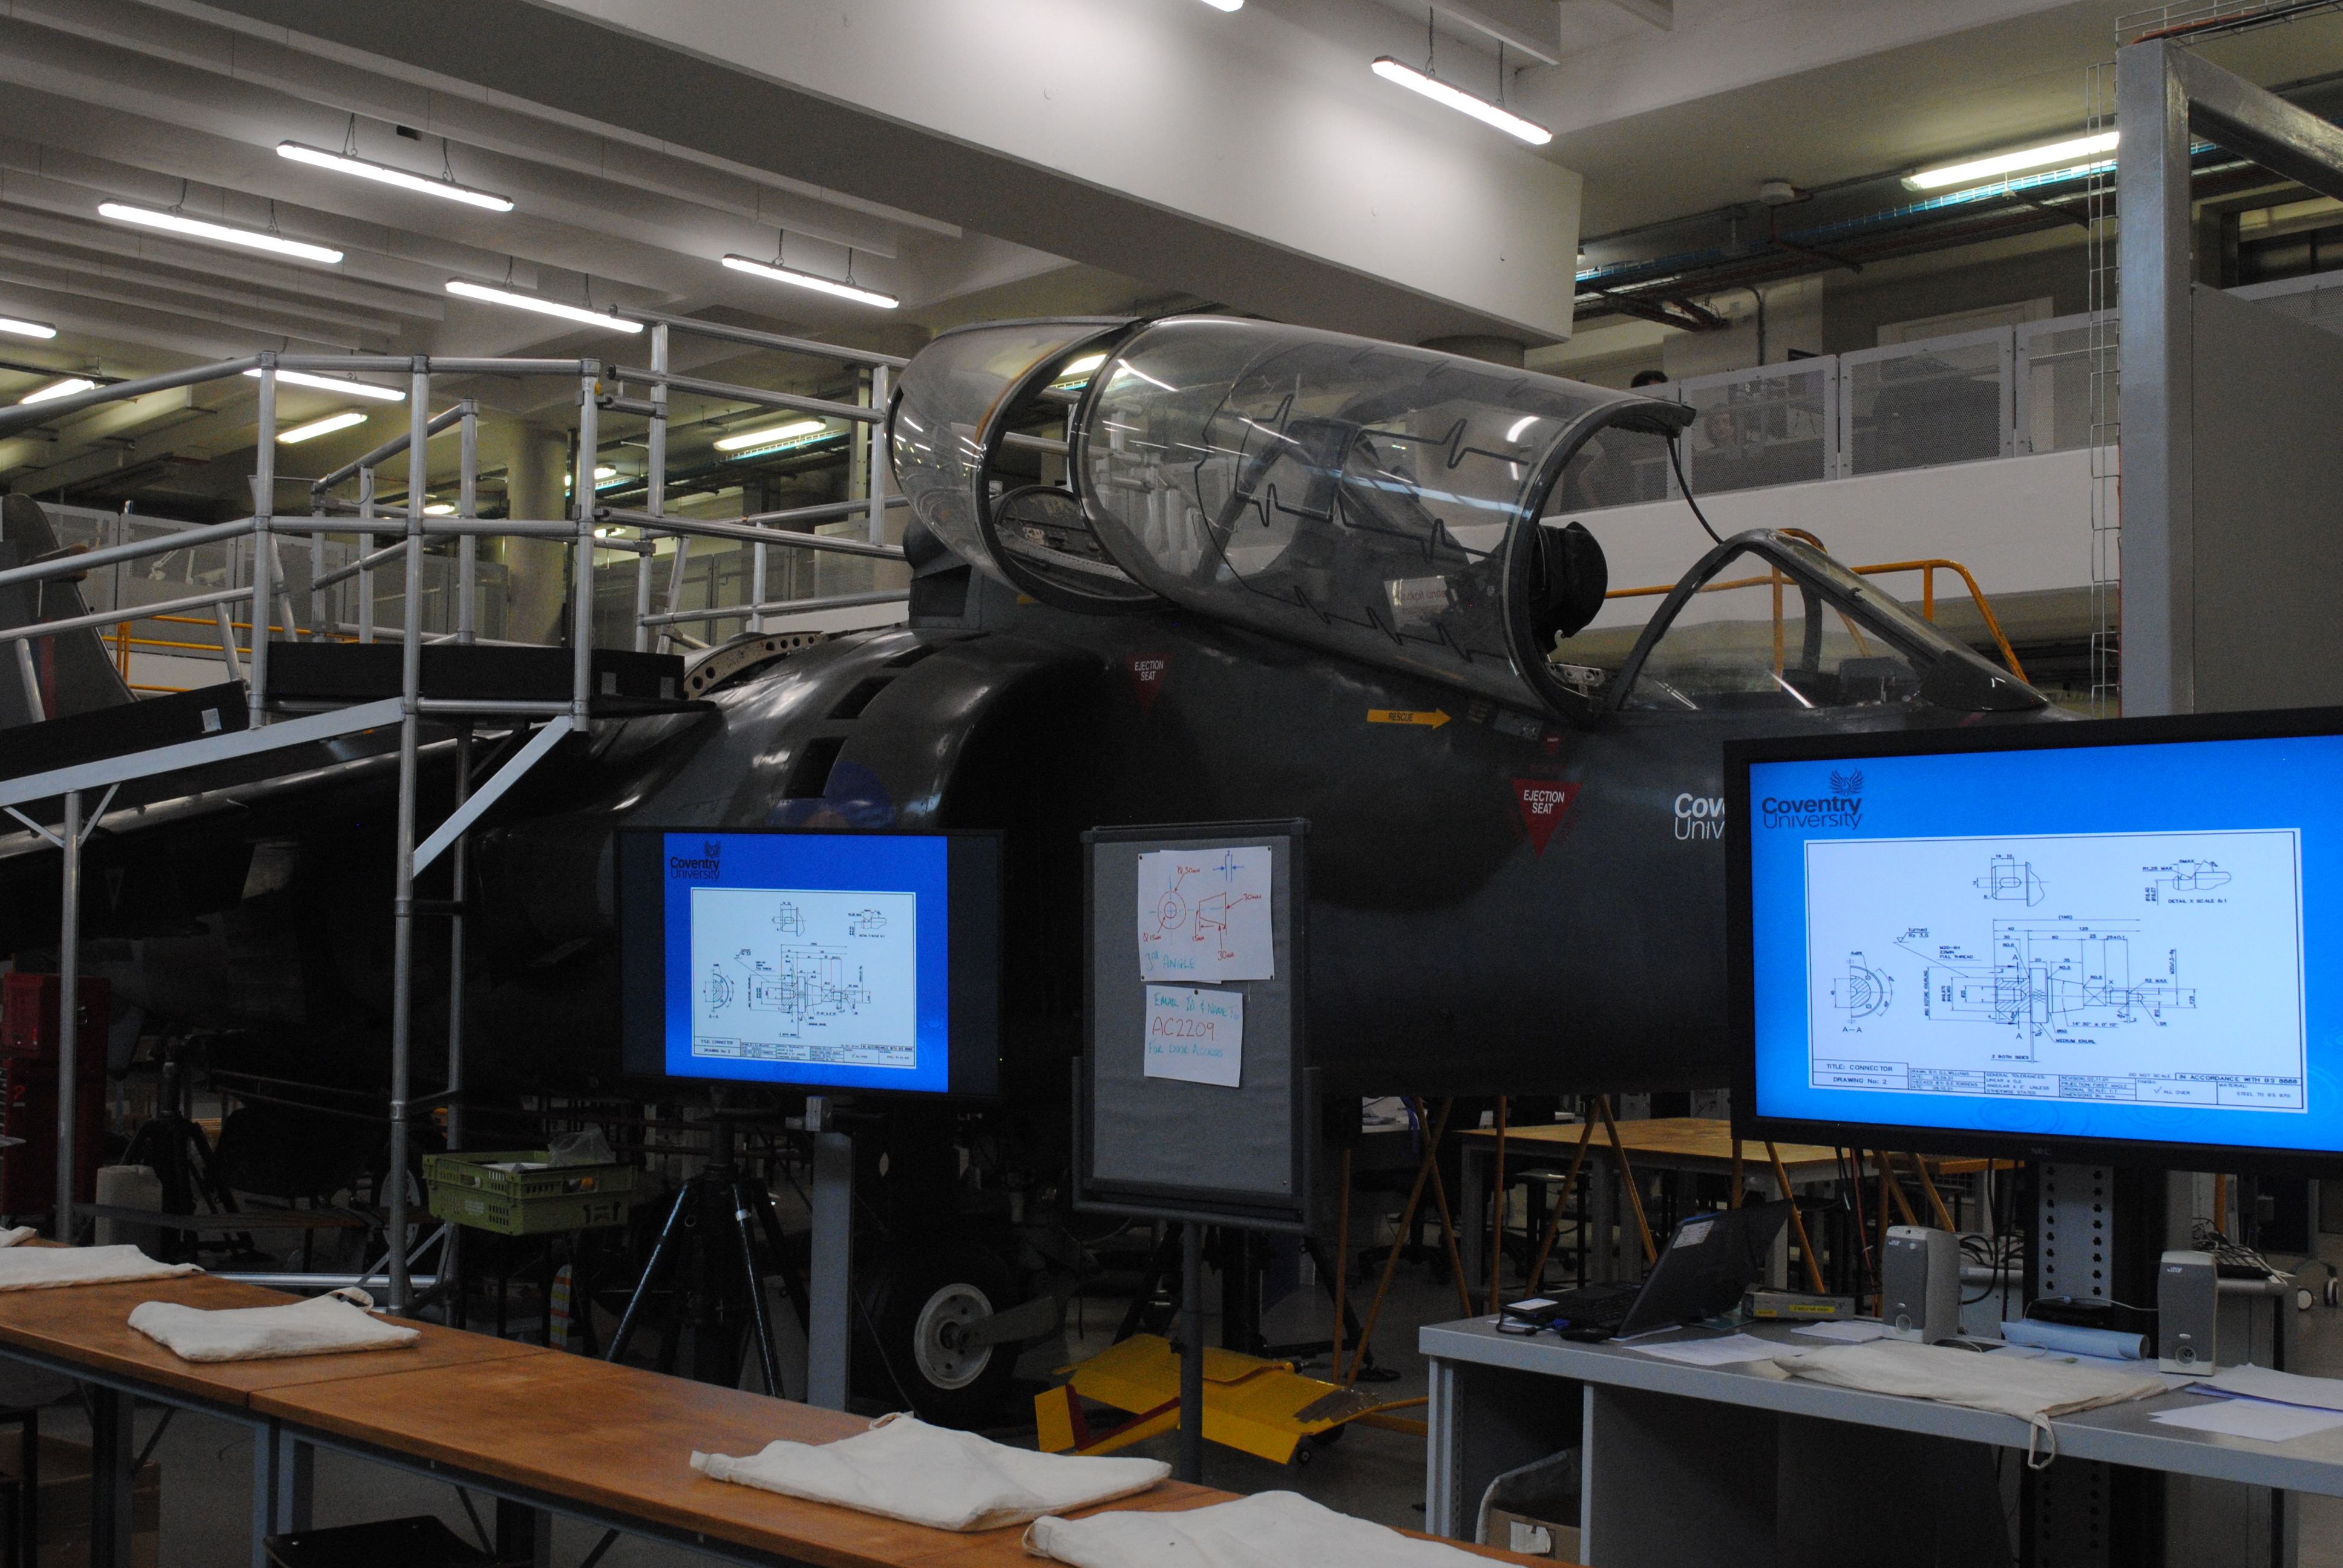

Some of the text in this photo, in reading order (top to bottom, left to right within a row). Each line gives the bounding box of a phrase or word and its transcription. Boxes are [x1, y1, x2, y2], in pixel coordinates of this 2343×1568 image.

[1135, 661, 1164, 671] EJECTION
[1141, 671, 1156, 681] SEAT
[1389, 712, 1414, 722] RESCUE
[1524, 789, 1565, 803] EJECTION
[1532, 802, 1553, 814] SEAT
[1675, 793, 1725, 818] Cov
[1762, 796, 1862, 816] Coventry
[1763, 812, 1863, 830] University
[670, 857, 720, 872] Coventry
[670, 868, 720, 881] University
[1145, 951, 1196, 972] 3rd ANGLE
[1186, 996, 1195, 1011] ID
[1152, 1016, 1214, 1040] AC2209
